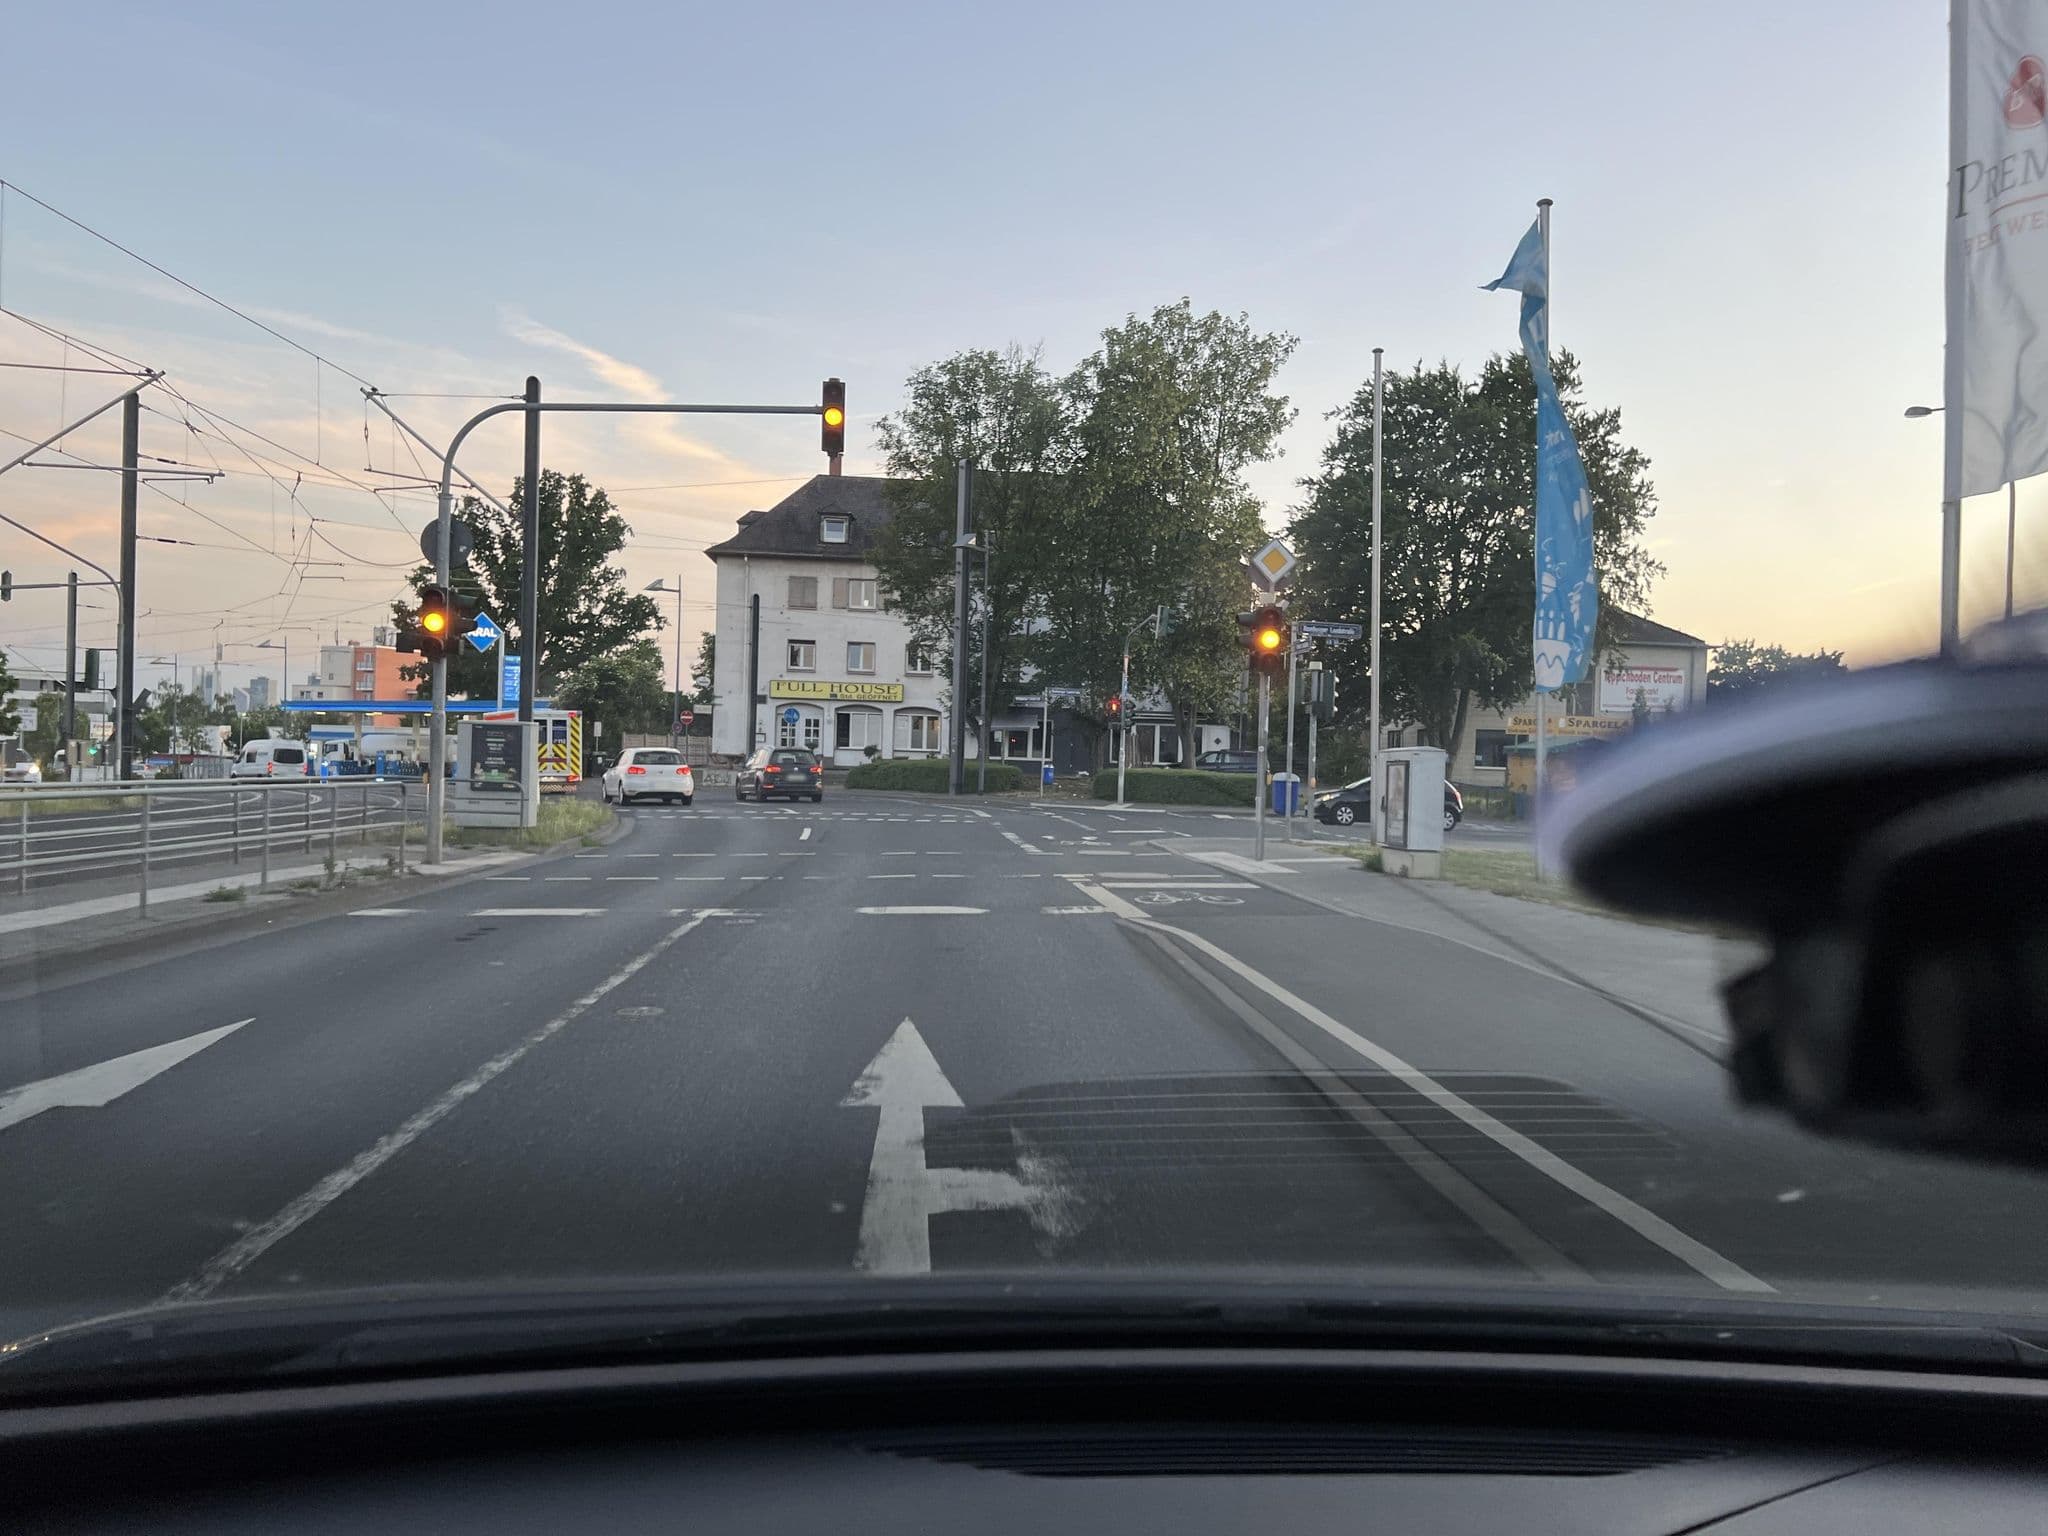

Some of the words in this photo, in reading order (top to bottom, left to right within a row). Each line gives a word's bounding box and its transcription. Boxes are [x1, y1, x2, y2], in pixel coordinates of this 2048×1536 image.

[1653, 671, 1683, 684] Centrum
[776, 682, 823, 693] FULL
[830, 683, 898, 695] HOUSE
[1568, 717, 1622, 729] SPARGEL
